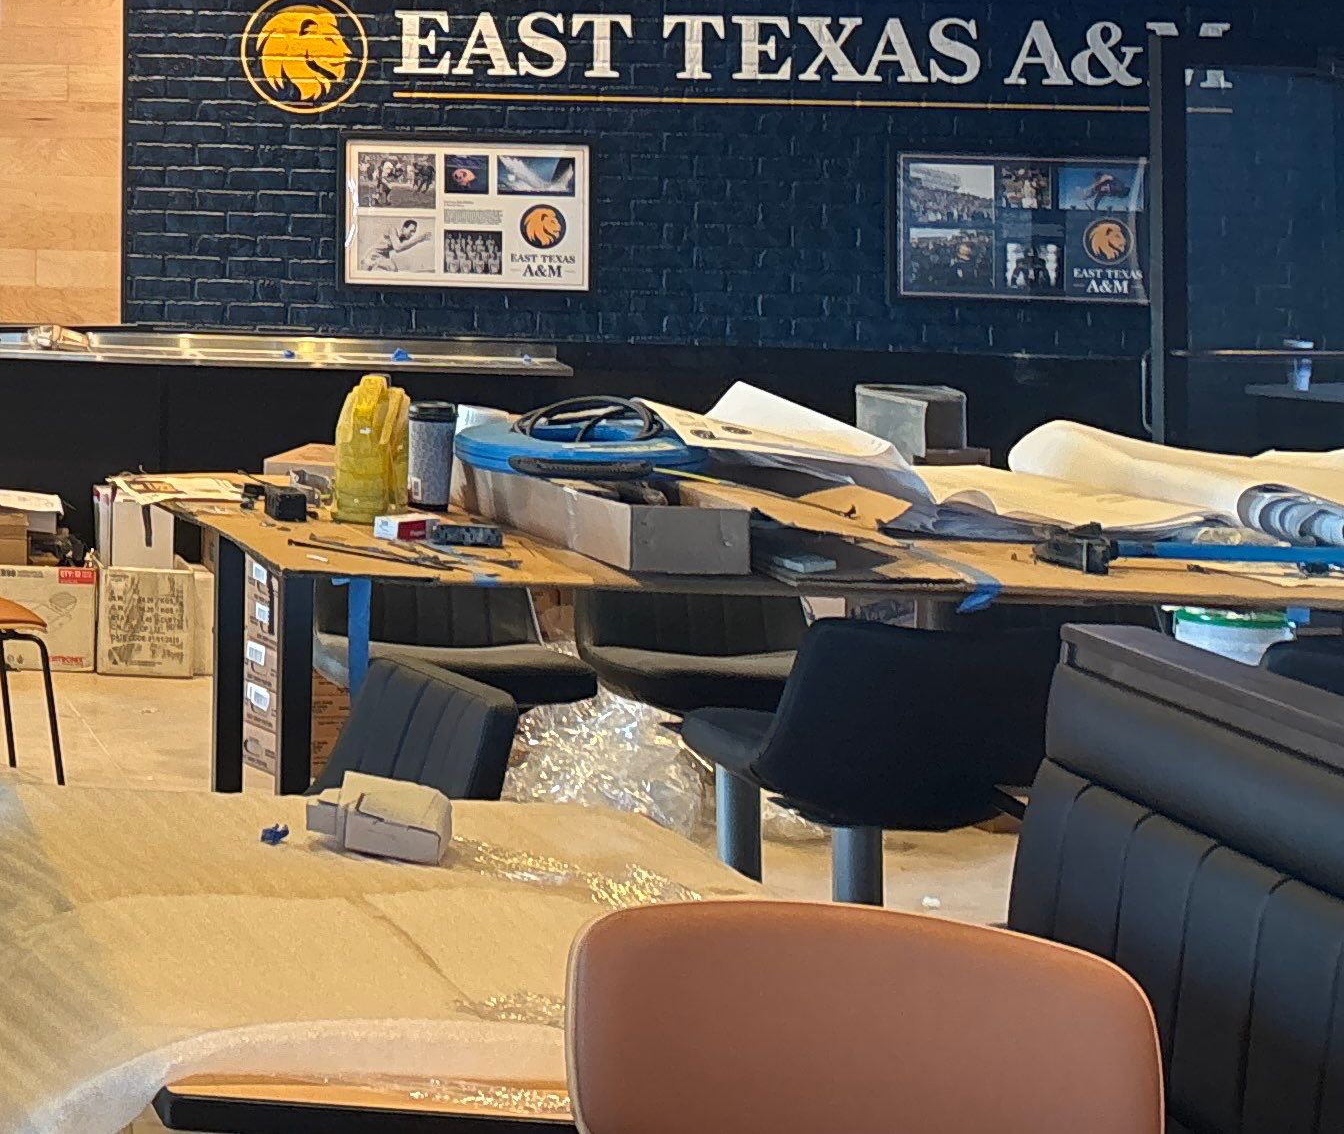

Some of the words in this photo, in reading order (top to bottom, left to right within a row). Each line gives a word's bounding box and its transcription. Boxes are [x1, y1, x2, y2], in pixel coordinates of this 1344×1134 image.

[393, 9, 632, 79] EAST
[662, 14, 981, 84] TEXAS
[510, 253, 540, 264] EAST
[541, 254, 576, 265] TEXAS
[522, 265, 563, 278] A&M
[1073, 267, 1104, 278] EAST
[1105, 268, 1144, 280] TEXAS
[1086, 279, 1129, 294] A&M
